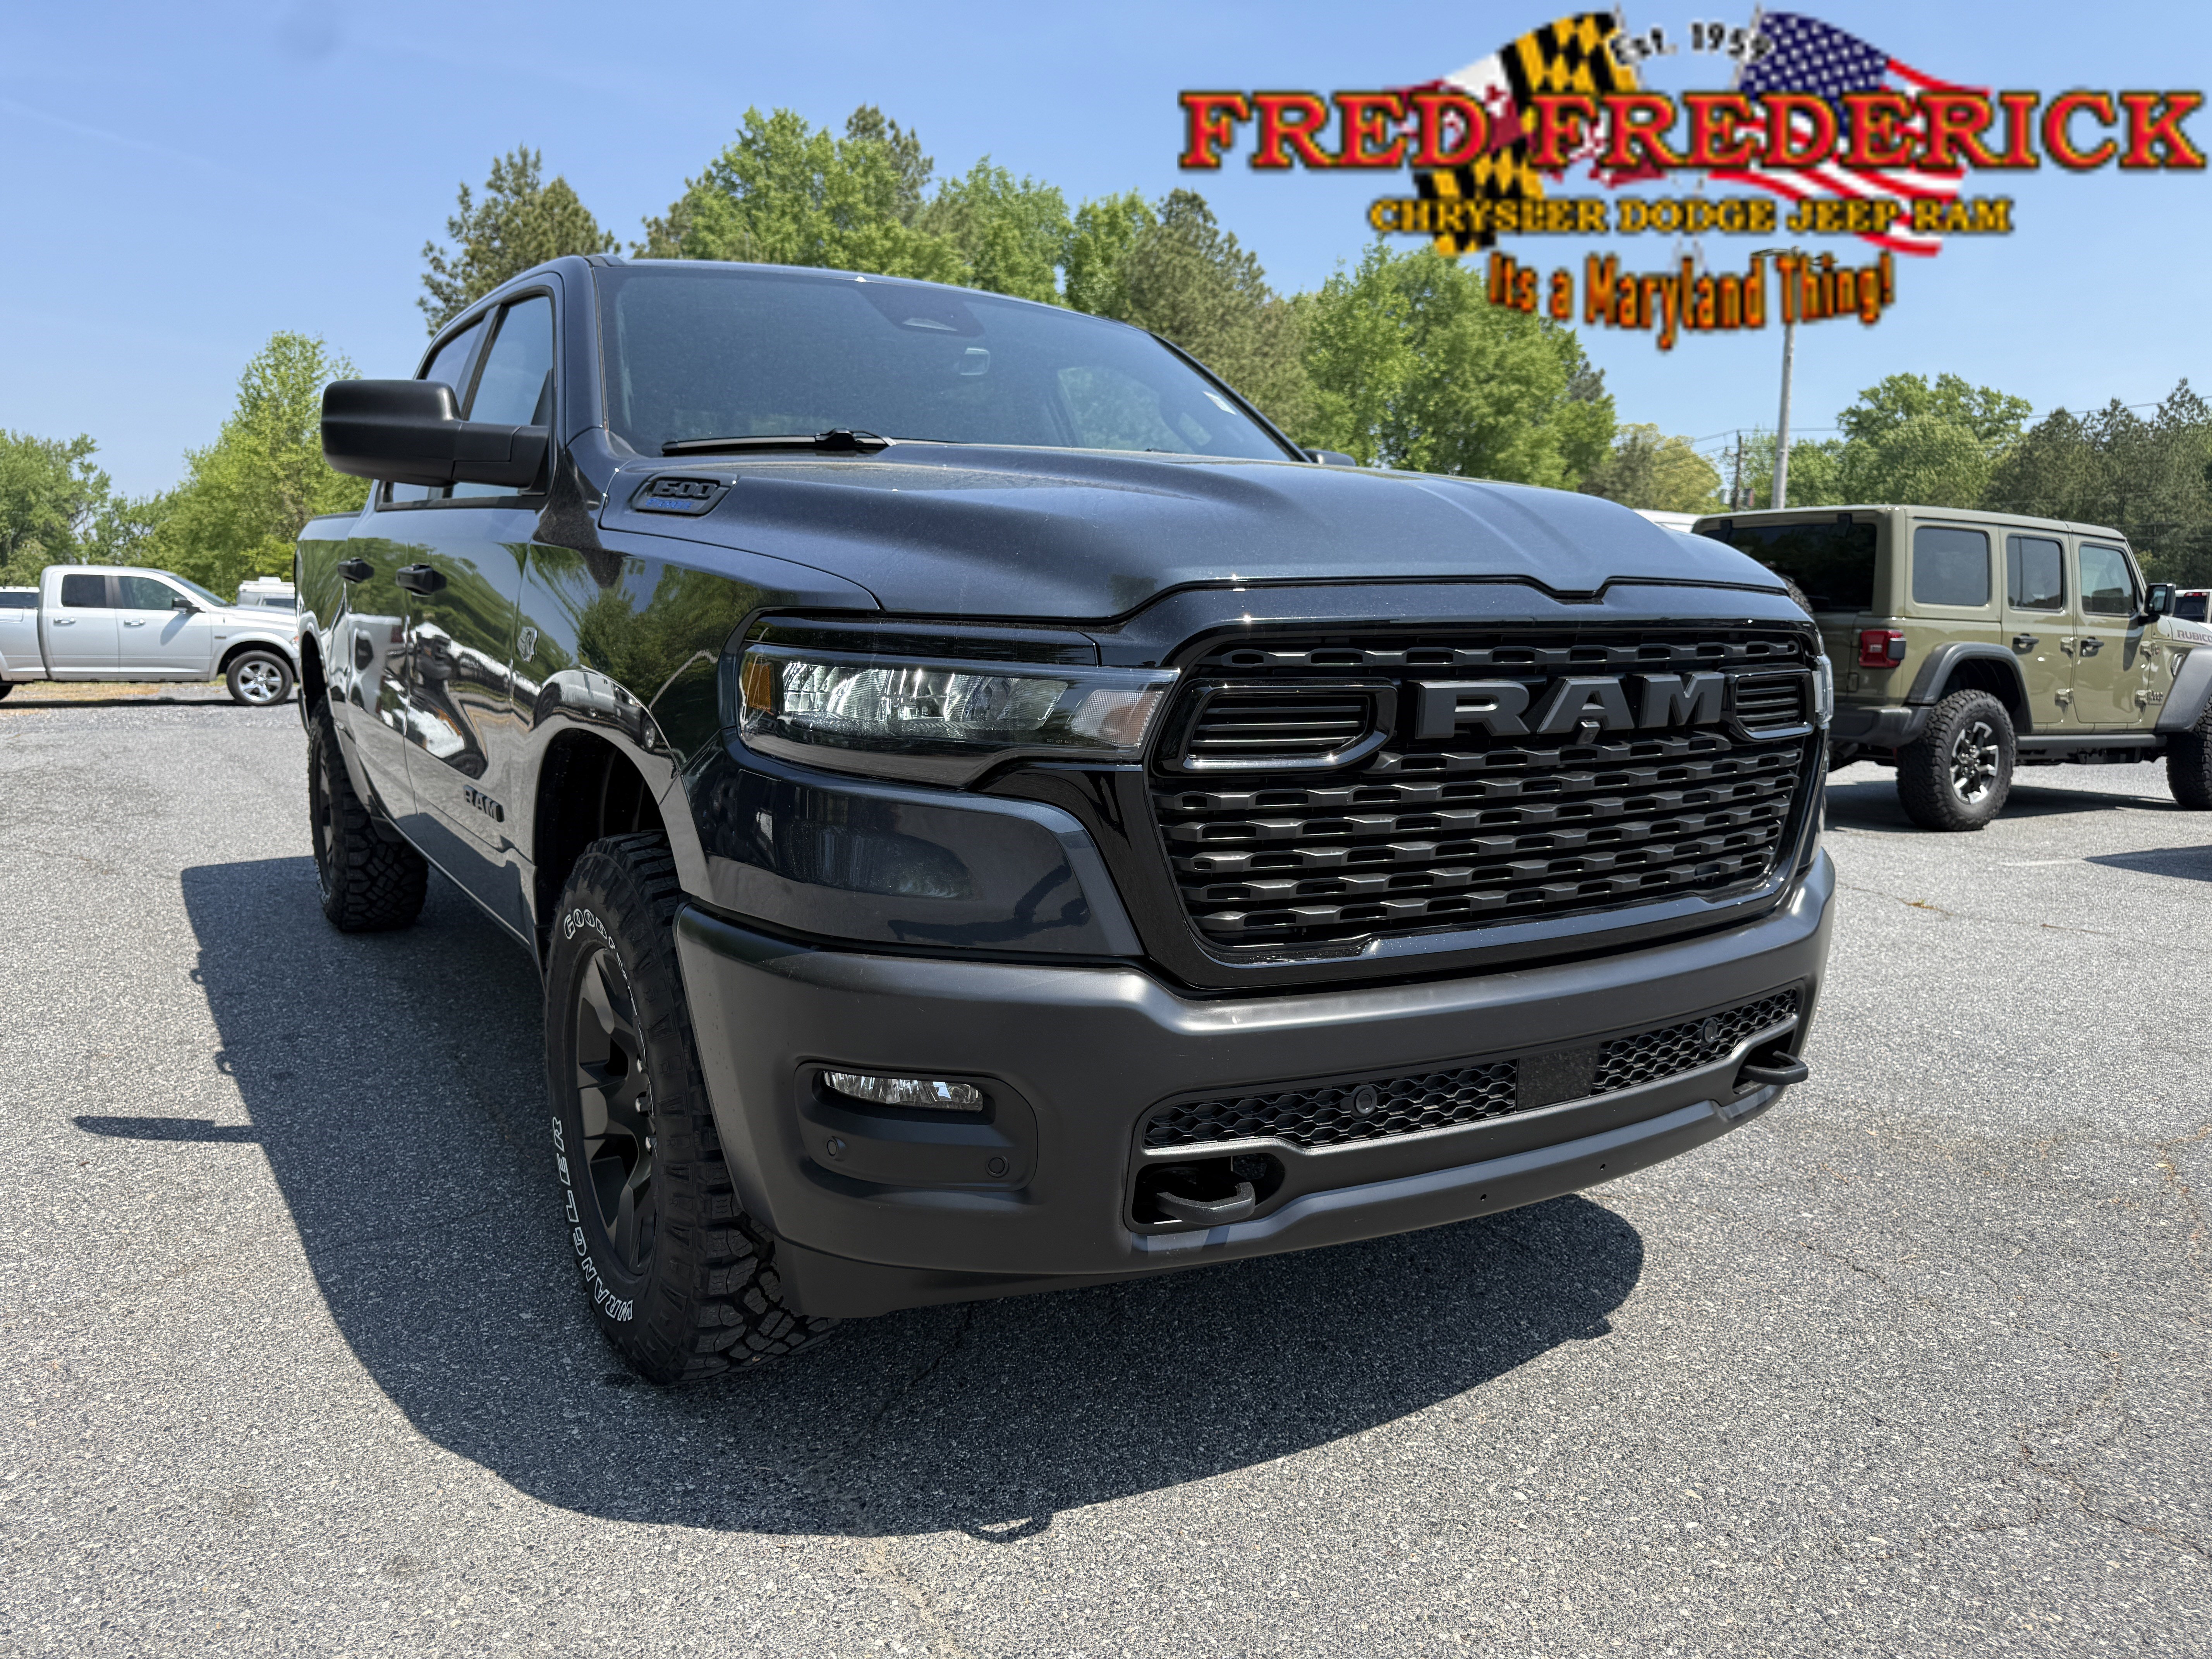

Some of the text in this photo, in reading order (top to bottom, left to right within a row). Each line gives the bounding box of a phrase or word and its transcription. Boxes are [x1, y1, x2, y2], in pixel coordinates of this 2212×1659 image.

[1415, 671, 1725, 739] RAM
[463, 785, 505, 823] RAM
[552, 1116, 633, 1321] WRANGLER
